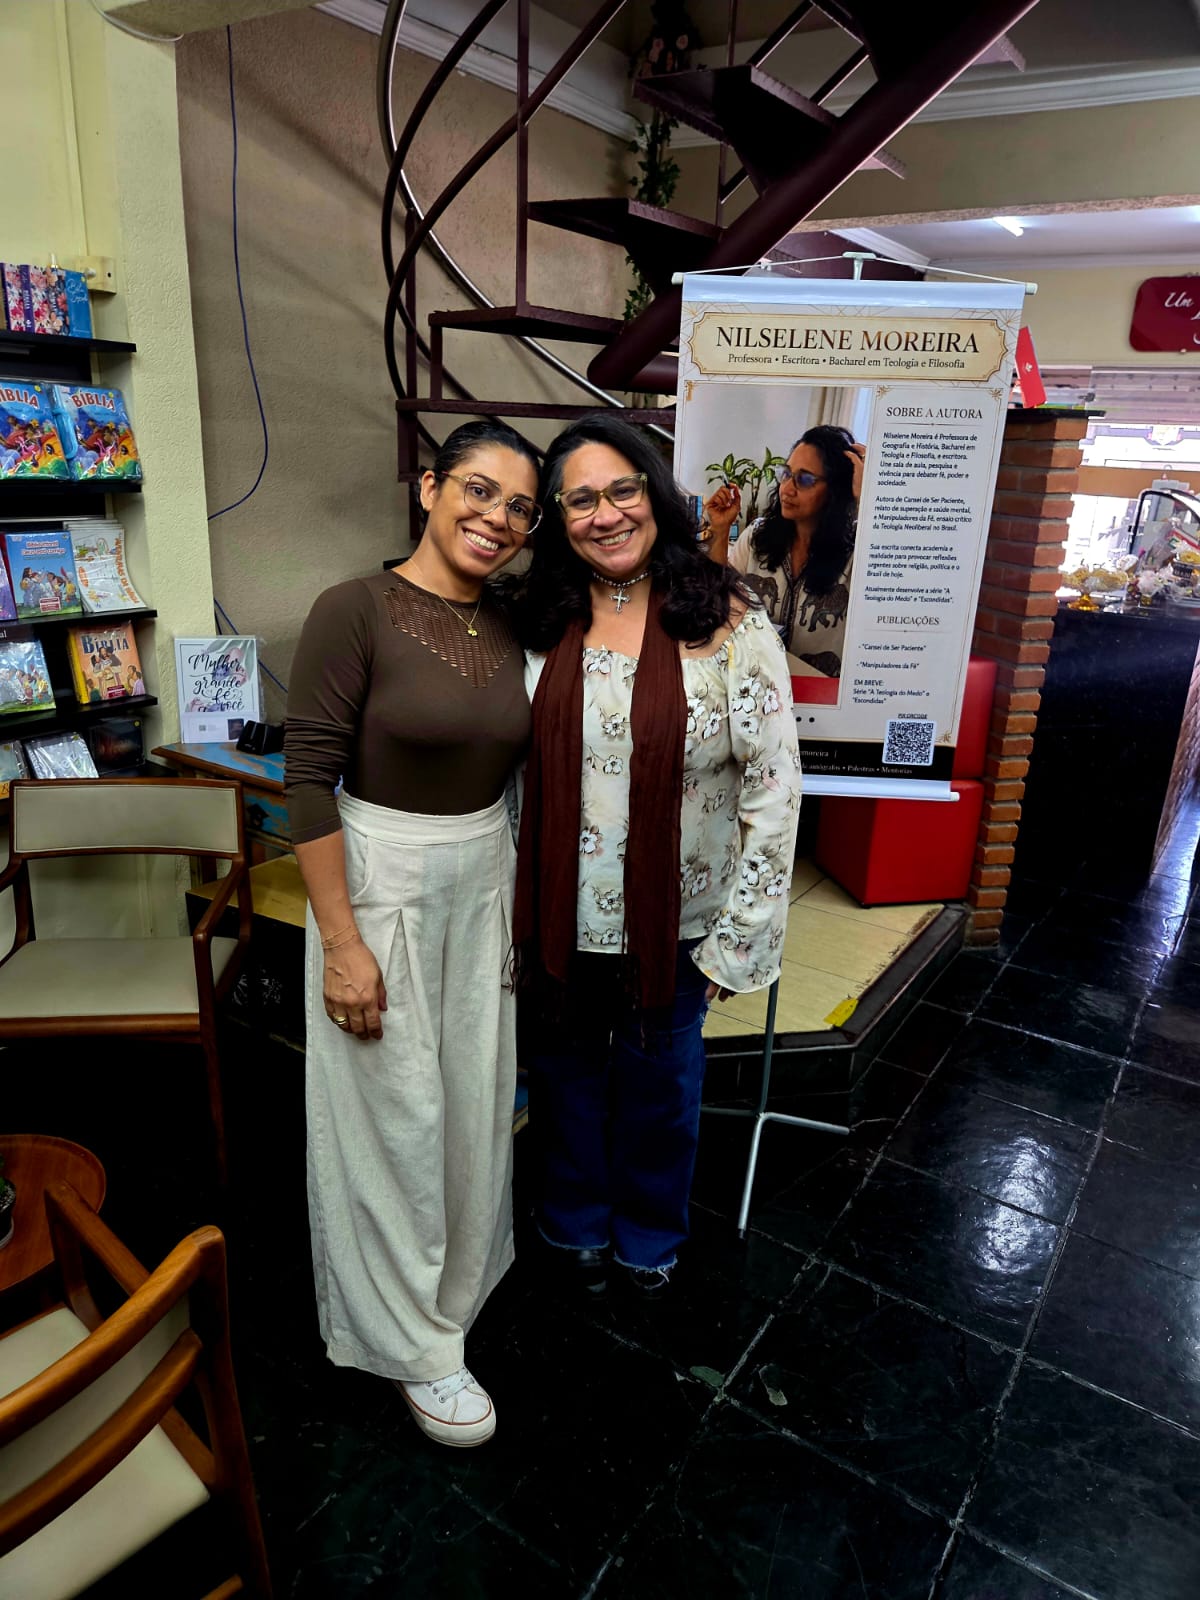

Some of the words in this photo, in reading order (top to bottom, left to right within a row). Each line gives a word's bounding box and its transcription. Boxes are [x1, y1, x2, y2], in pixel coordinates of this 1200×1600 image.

[716, 326, 852, 350] NILSELENE
[860, 330, 979, 353] MOREIRA
[729, 354, 772, 364] Professora
[782, 355, 820, 365] Escritora
[829, 356, 866, 366] Bacharel
[884, 358, 918, 369] Teologia
[929, 358, 964, 368] Filosofia
[887, 407, 923, 417] SOBRE
[925, 408, 933, 417] A
[936, 408, 982, 418] AUTORA
[882, 442, 909, 450] Geografia
[877, 616, 940, 626] PUBLICAÇÕES
